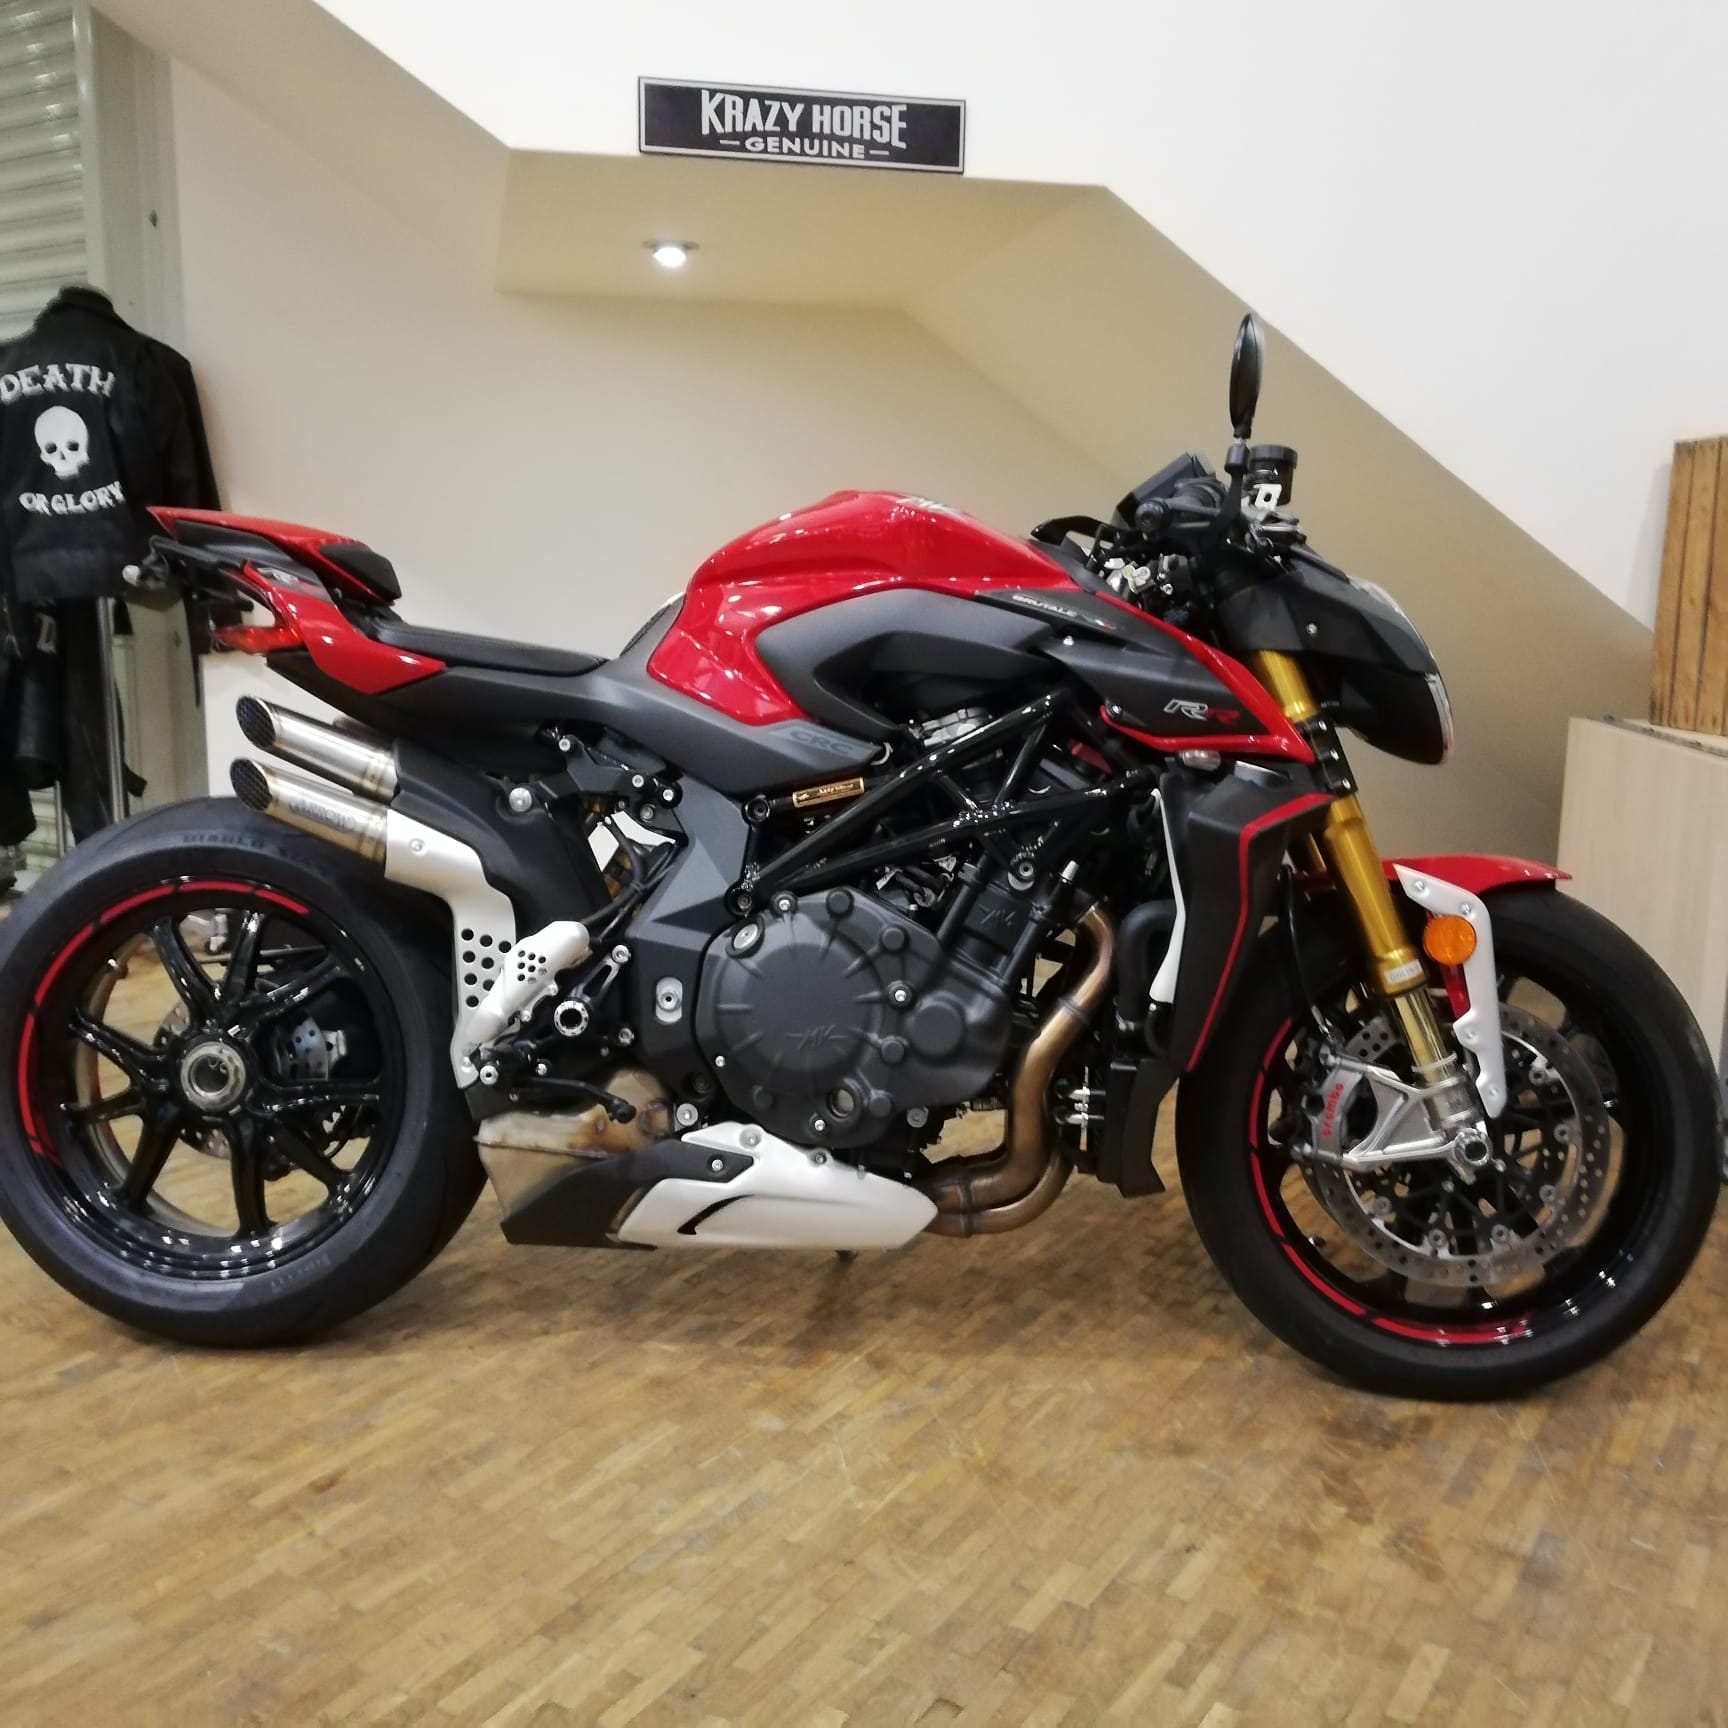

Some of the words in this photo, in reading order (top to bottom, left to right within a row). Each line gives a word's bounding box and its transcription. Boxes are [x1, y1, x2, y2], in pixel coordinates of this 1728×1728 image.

[702, 90, 804, 135] KRAZY
[812, 104, 907, 149] HORSE
[744, 137, 865, 158] GENUINE
[0, 363, 115, 403] DEATH
[19, 492, 51, 516] OR
[51, 481, 124, 515] GLORY
